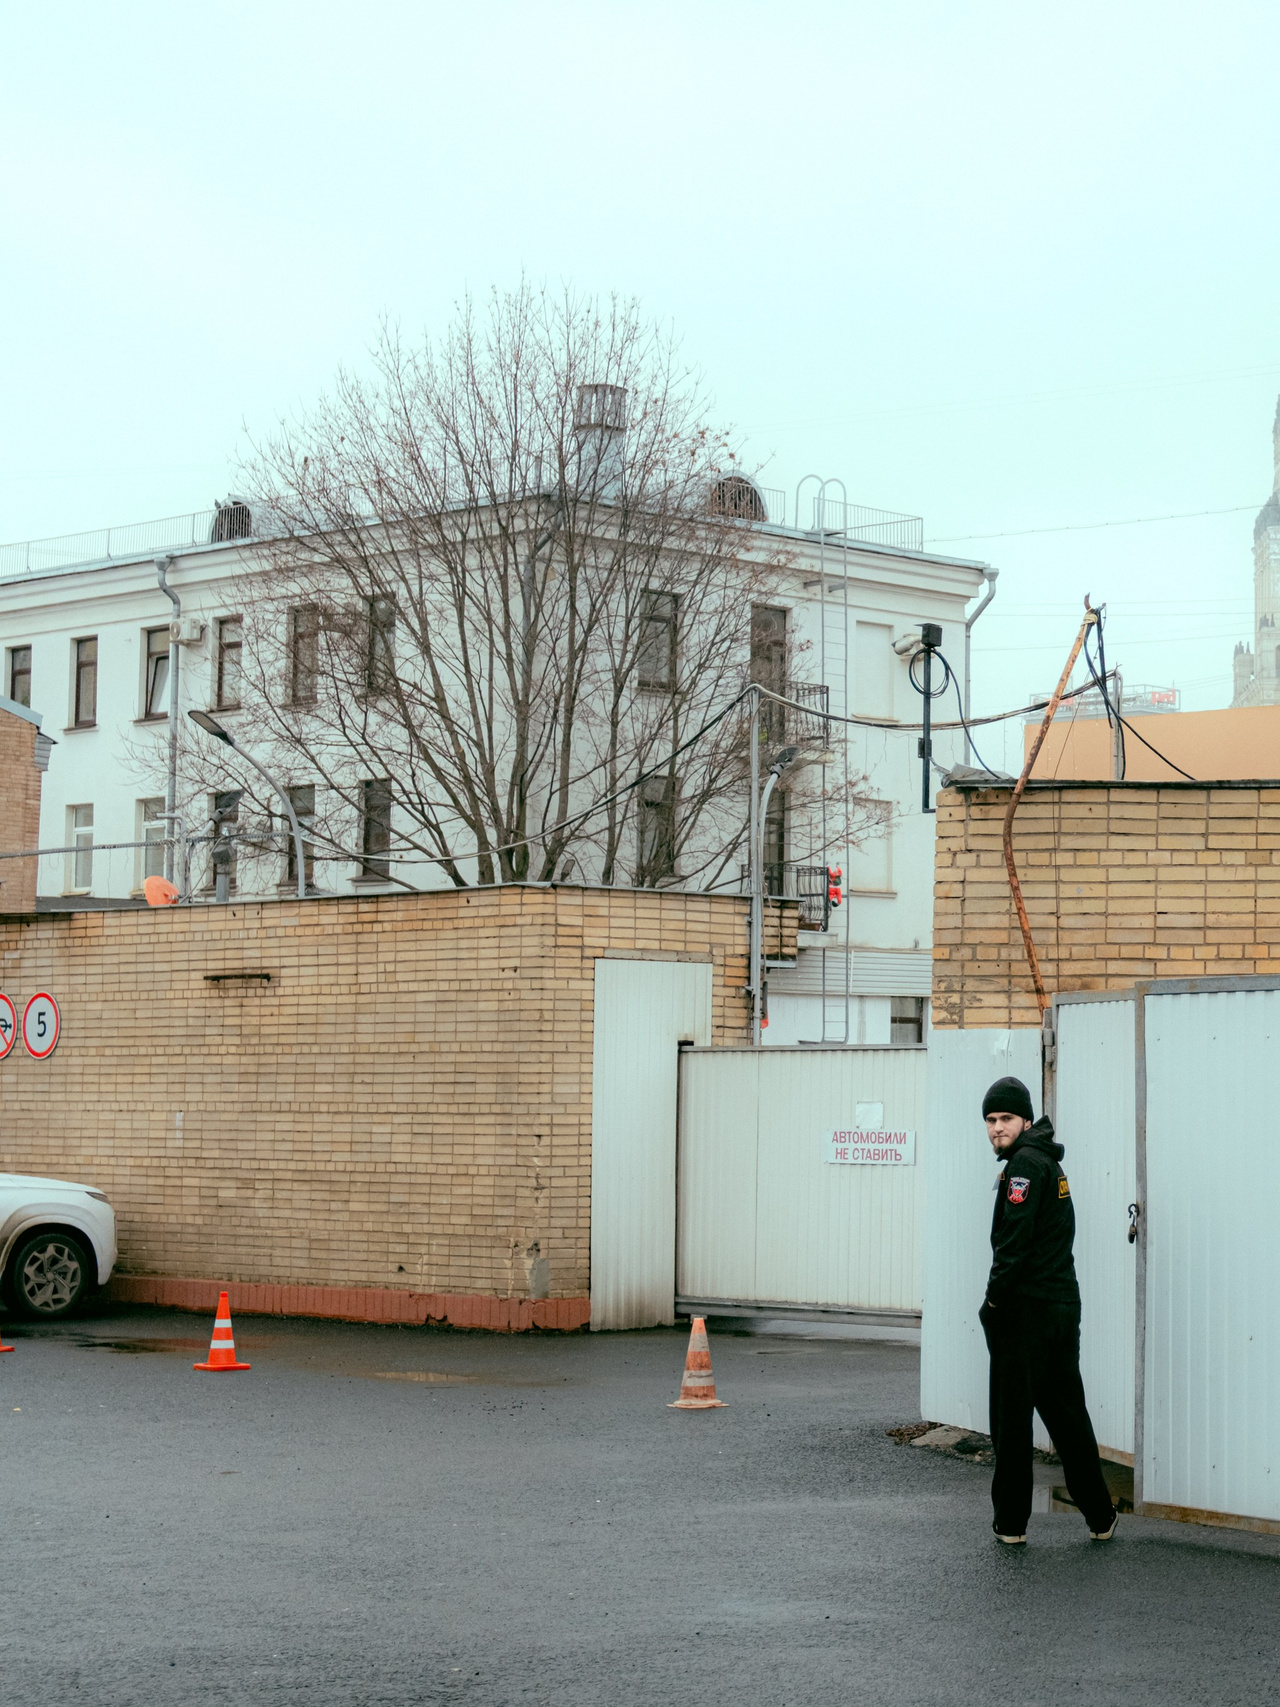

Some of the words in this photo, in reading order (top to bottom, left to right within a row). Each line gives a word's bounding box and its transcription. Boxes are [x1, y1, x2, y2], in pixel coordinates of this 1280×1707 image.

[37, 1011, 47, 1038] 5
[831, 1131, 907, 1145] АВТОМОБИЛИ
[835, 1147, 849, 1160] НЕ
[852, 1147, 902, 1161] СТАВИТЬ
